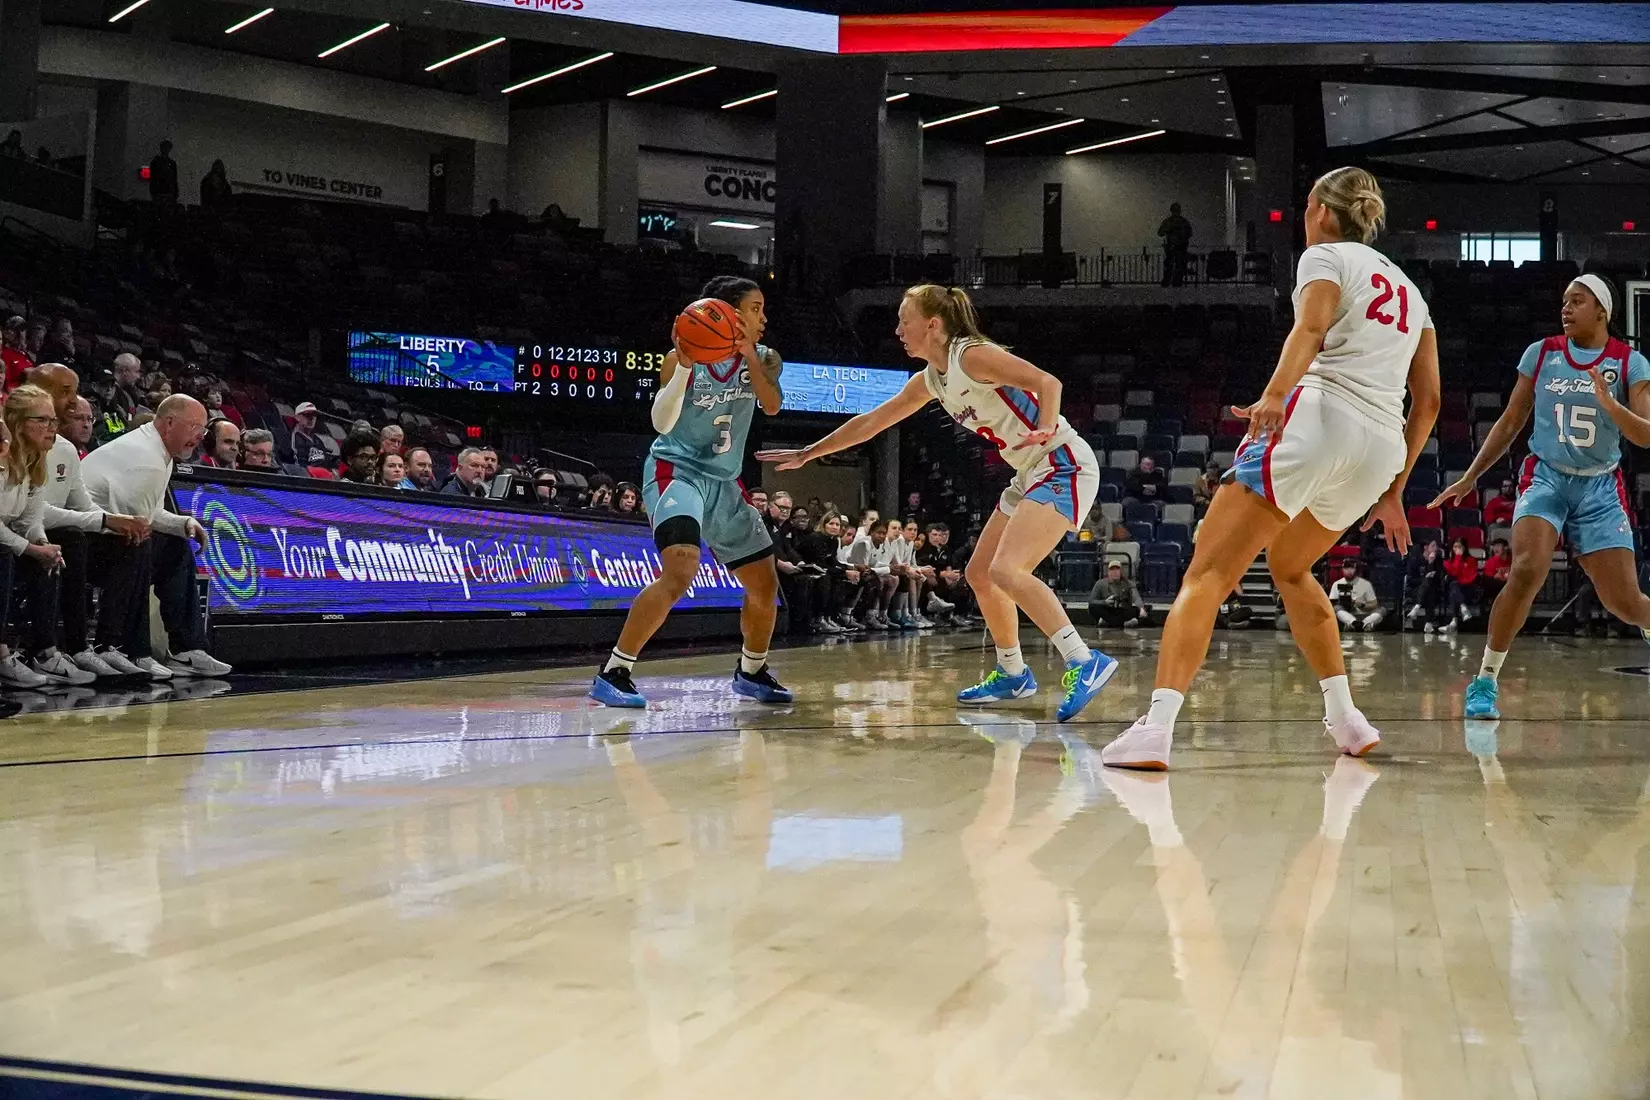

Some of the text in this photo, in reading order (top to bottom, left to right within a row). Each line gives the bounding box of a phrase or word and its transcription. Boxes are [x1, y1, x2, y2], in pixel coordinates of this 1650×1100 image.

[432, 163, 444, 176] 6
[263, 168, 383, 199] TO VINES CENTER
[1047, 191, 1059, 205] 7
[1365, 272, 1409, 335] 21
[400, 336, 466, 353] LIBERTY
[518, 345, 618, 364] # 0 12 21 23 31
[625, 351, 665, 372] 8:33
[425, 355, 440, 376] 5
[518, 363, 614, 382] F 0 0 0 0 0
[813, 366, 868, 382] LA TECH
[493, 383, 499, 392] 4
[514, 381, 613, 399] PT 2 3 0 0 0
[637, 378, 653, 388] 1ST
[834, 383, 846, 403] 0
[711, 414, 733, 454] 3
[1554, 402, 1597, 448] 15
[270, 527, 327, 579] Your
[326, 525, 471, 600] Community
[465, 540, 517, 583] Credit
[515, 543, 564, 584] Union
[591, 548, 657, 588] Central
